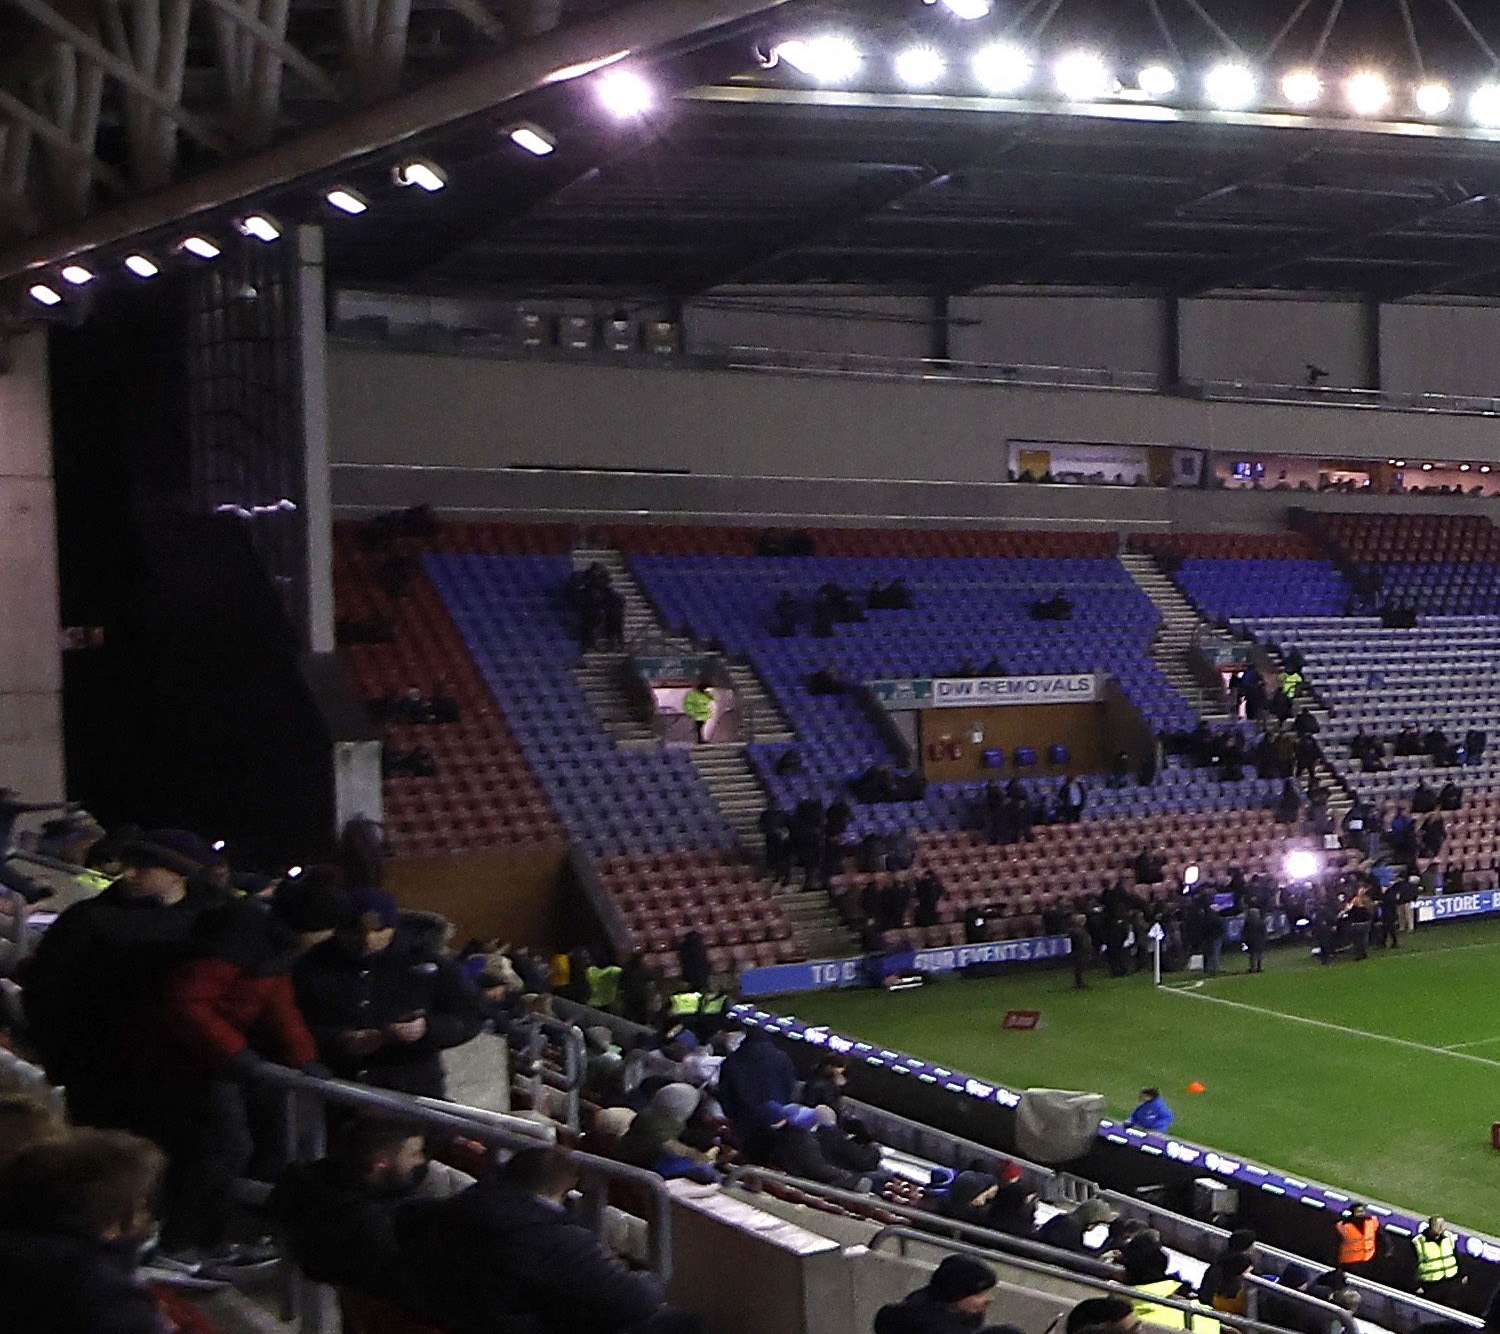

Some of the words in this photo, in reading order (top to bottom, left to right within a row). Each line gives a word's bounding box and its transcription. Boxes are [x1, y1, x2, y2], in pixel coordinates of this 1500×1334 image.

[937, 680, 973, 696] DW
[978, 677, 1089, 695] REMOVALS
[1436, 894, 1481, 915] STORE
[957, 943, 1030, 967] EVENTS
